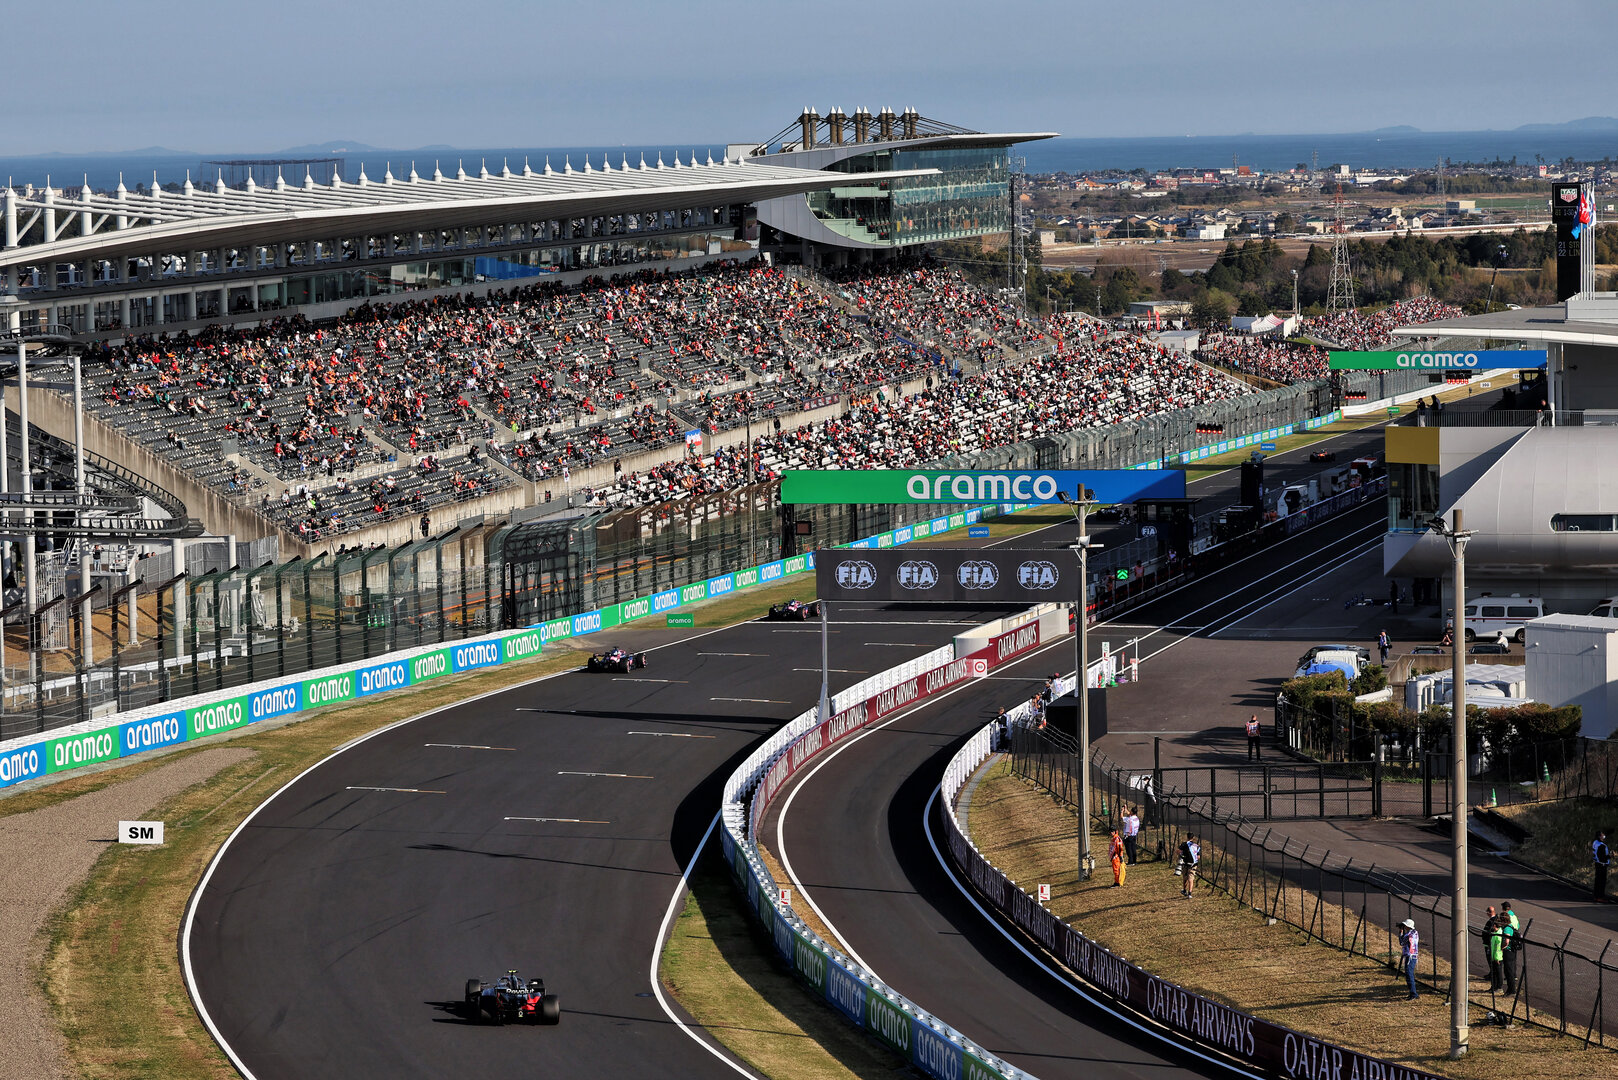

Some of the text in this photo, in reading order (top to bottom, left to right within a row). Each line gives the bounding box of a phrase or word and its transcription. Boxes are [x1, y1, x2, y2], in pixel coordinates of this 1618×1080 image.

[1397, 353, 1478, 367] aramco
[906, 474, 1058, 500] aramco
[895, 528, 911, 543] aramco
[914, 524, 930, 537] aramco
[932, 519, 947, 532] aramco
[761, 564, 781, 580] aramco
[785, 557, 805, 573] aramco
[710, 577, 731, 594] aramco
[736, 570, 757, 587] aramco
[654, 592, 678, 610] aramco
[683, 585, 705, 602] aramco
[624, 600, 649, 618] aramco
[575, 614, 600, 633] aramco
[457, 643, 498, 667] aramco
[506, 633, 539, 658] aramco
[997, 624, 1037, 660] QATAR AIRWAYS
[361, 664, 405, 692] aramco
[414, 653, 446, 679] aramco
[926, 658, 967, 694] QATAR AIRWAYS
[253, 688, 296, 717] aramco
[309, 677, 351, 704] aramco
[876, 678, 918, 717] QATAR AIRWAYS
[194, 702, 242, 734] aramco
[828, 701, 868, 743] QATAR AIRWAYS
[126, 717, 179, 749] aramco
[54, 733, 113, 766] aramco
[128, 826, 154, 840] SM
[796, 941, 823, 987] aramco
[1065, 929, 1130, 1000] QATAR AIRWAYS
[830, 967, 861, 1018] aramco
[870, 998, 908, 1051] aramco
[1147, 978, 1255, 1057] QATAR AIRWAYS
[917, 1029, 957, 1080] aramco
[1283, 1033, 1343, 1080] QATAR
